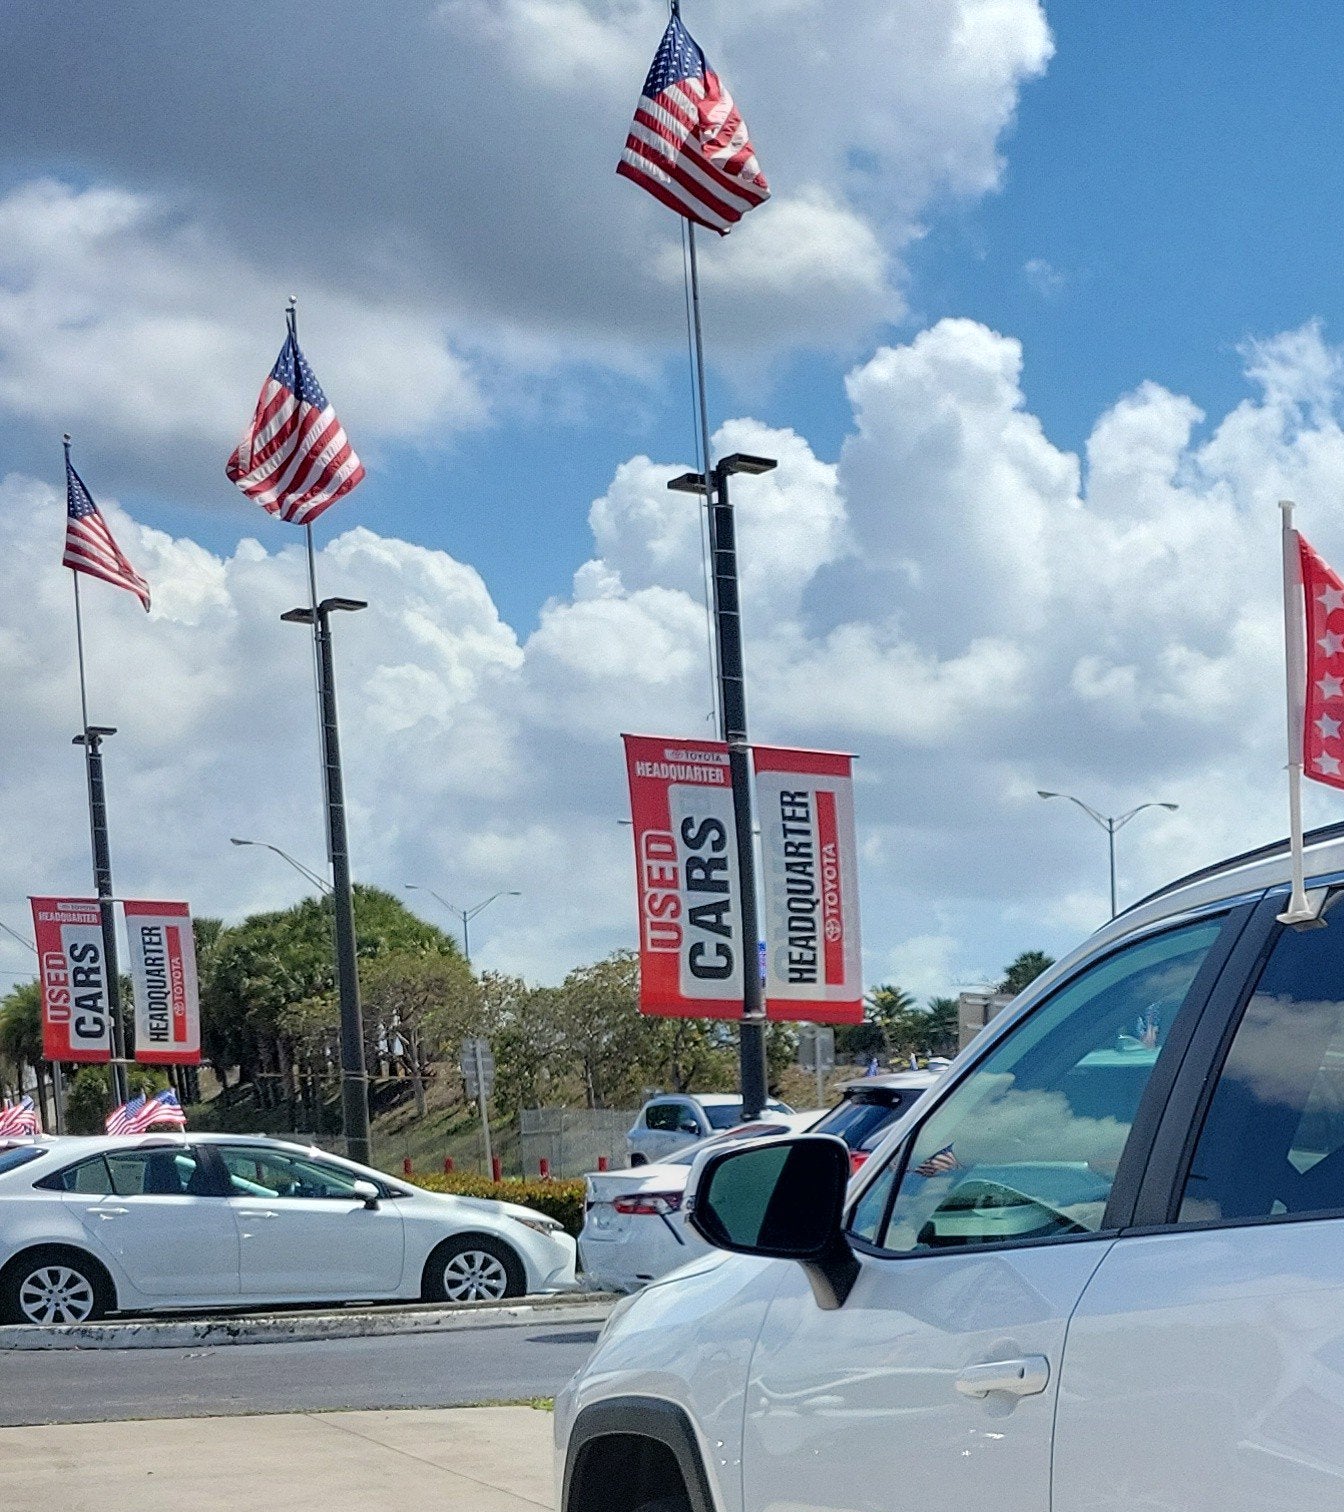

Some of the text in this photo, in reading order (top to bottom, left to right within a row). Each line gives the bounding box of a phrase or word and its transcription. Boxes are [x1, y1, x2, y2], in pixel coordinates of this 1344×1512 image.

[635, 761, 725, 784] HEADQUARTER
[685, 750, 722, 763] TOYOTA
[641, 829, 683, 952] USED
[681, 816, 734, 980] CARS
[780, 789, 820, 984] HEADQUARTER
[821, 843, 837, 917] TOYOTA
[44, 952, 72, 1023] USED
[69, 943, 106, 1039] CARS
[141, 925, 170, 1042] HEADQUARTER
